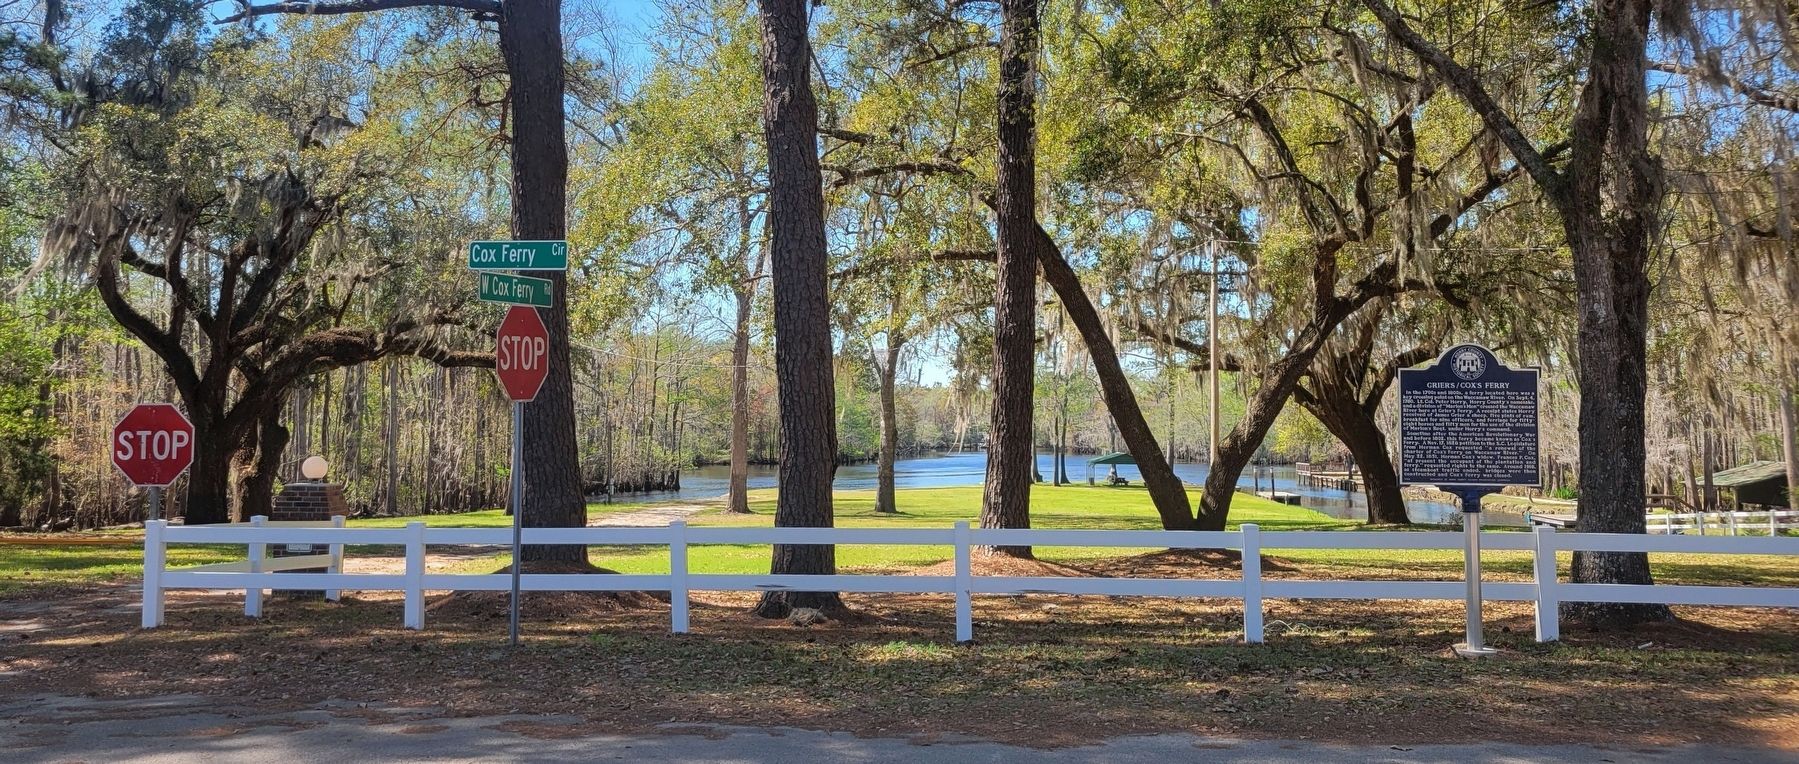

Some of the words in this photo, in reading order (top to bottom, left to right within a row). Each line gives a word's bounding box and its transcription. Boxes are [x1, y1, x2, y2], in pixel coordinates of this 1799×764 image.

[472, 244, 496, 262] Cox
[501, 244, 536, 267] Ferry
[551, 243, 565, 256] Cir
[481, 275, 490, 295] W
[492, 276, 509, 296] Cox
[512, 278, 534, 303] Ferry
[500, 335, 545, 370] STOP
[117, 430, 189, 461] STOP
